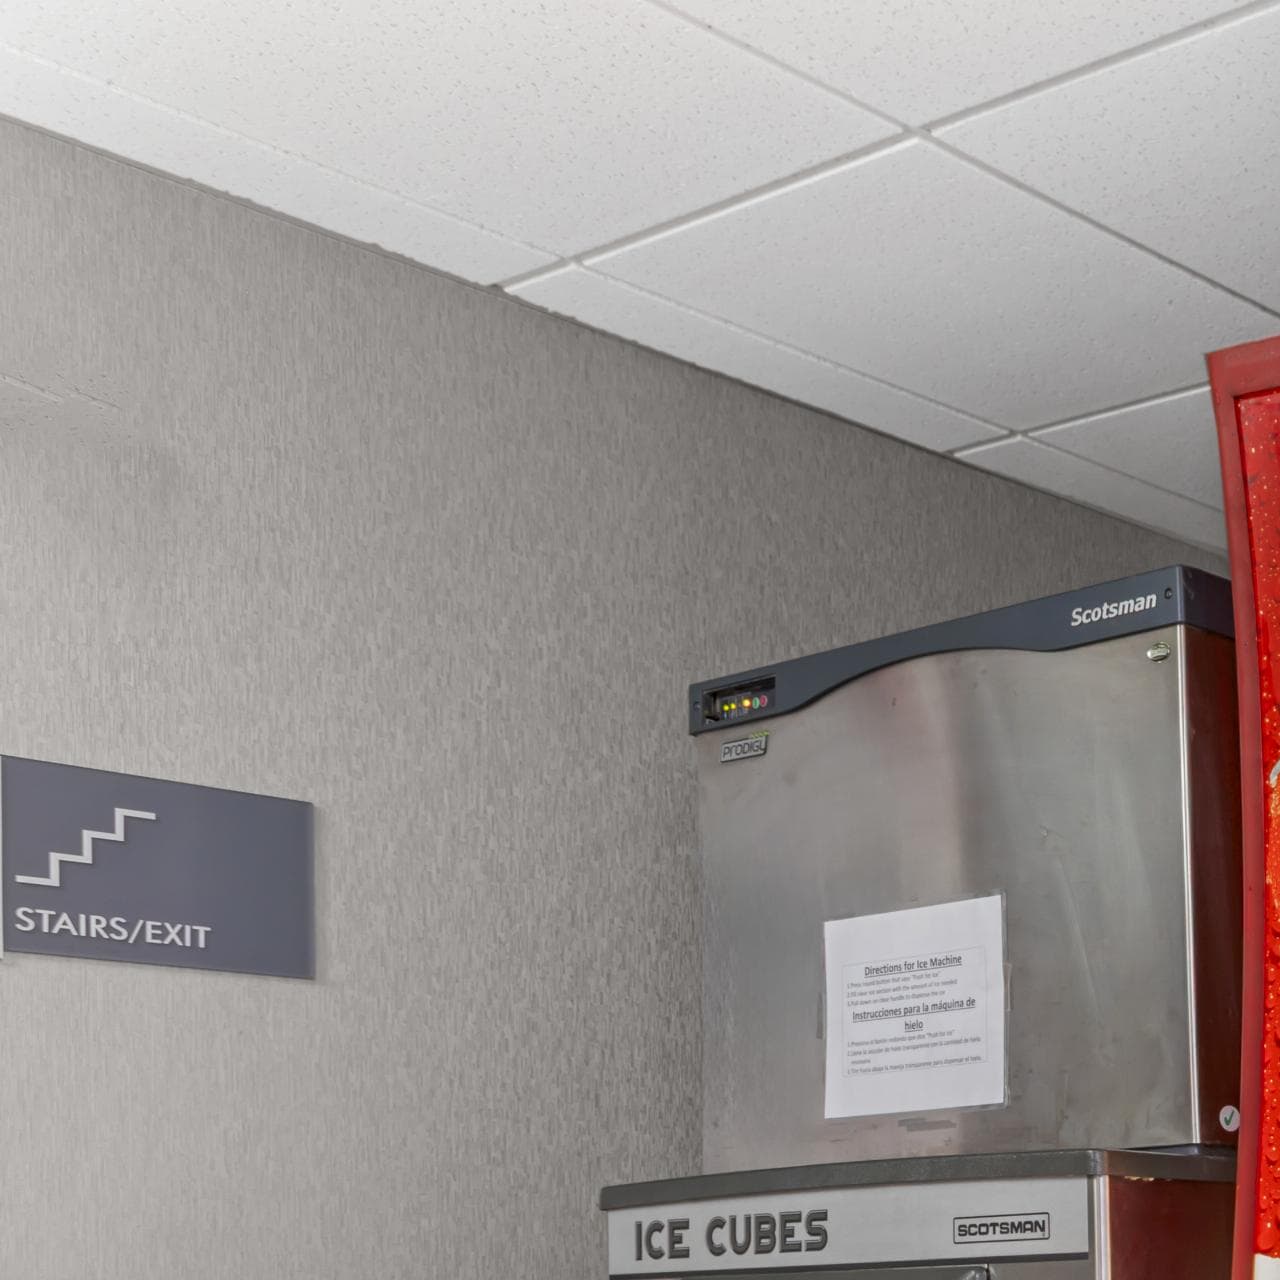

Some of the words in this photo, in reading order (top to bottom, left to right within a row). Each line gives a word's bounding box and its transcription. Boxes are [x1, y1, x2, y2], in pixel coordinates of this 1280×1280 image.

[1070, 592, 1157, 627] Scotsman
[15, 906, 212, 949] STAIRS/EXIT
[864, 963, 902, 977] Directions
[904, 960, 915, 971] for
[917, 958, 928, 969] Ice
[930, 954, 962, 967] Machine
[852, 1007, 902, 1021] Instrucciones
[903, 1005, 921, 1017] para
[922, 1002, 929, 1012] la
[931, 999, 964, 1013] máquina
[966, 996, 976, 1007] de
[904, 1019, 924, 1031] hielo
[635, 1217, 690, 1261] ICE
[705, 1208, 829, 1257] CUBES
[957, 1218, 1047, 1238] SCOTSMAN
